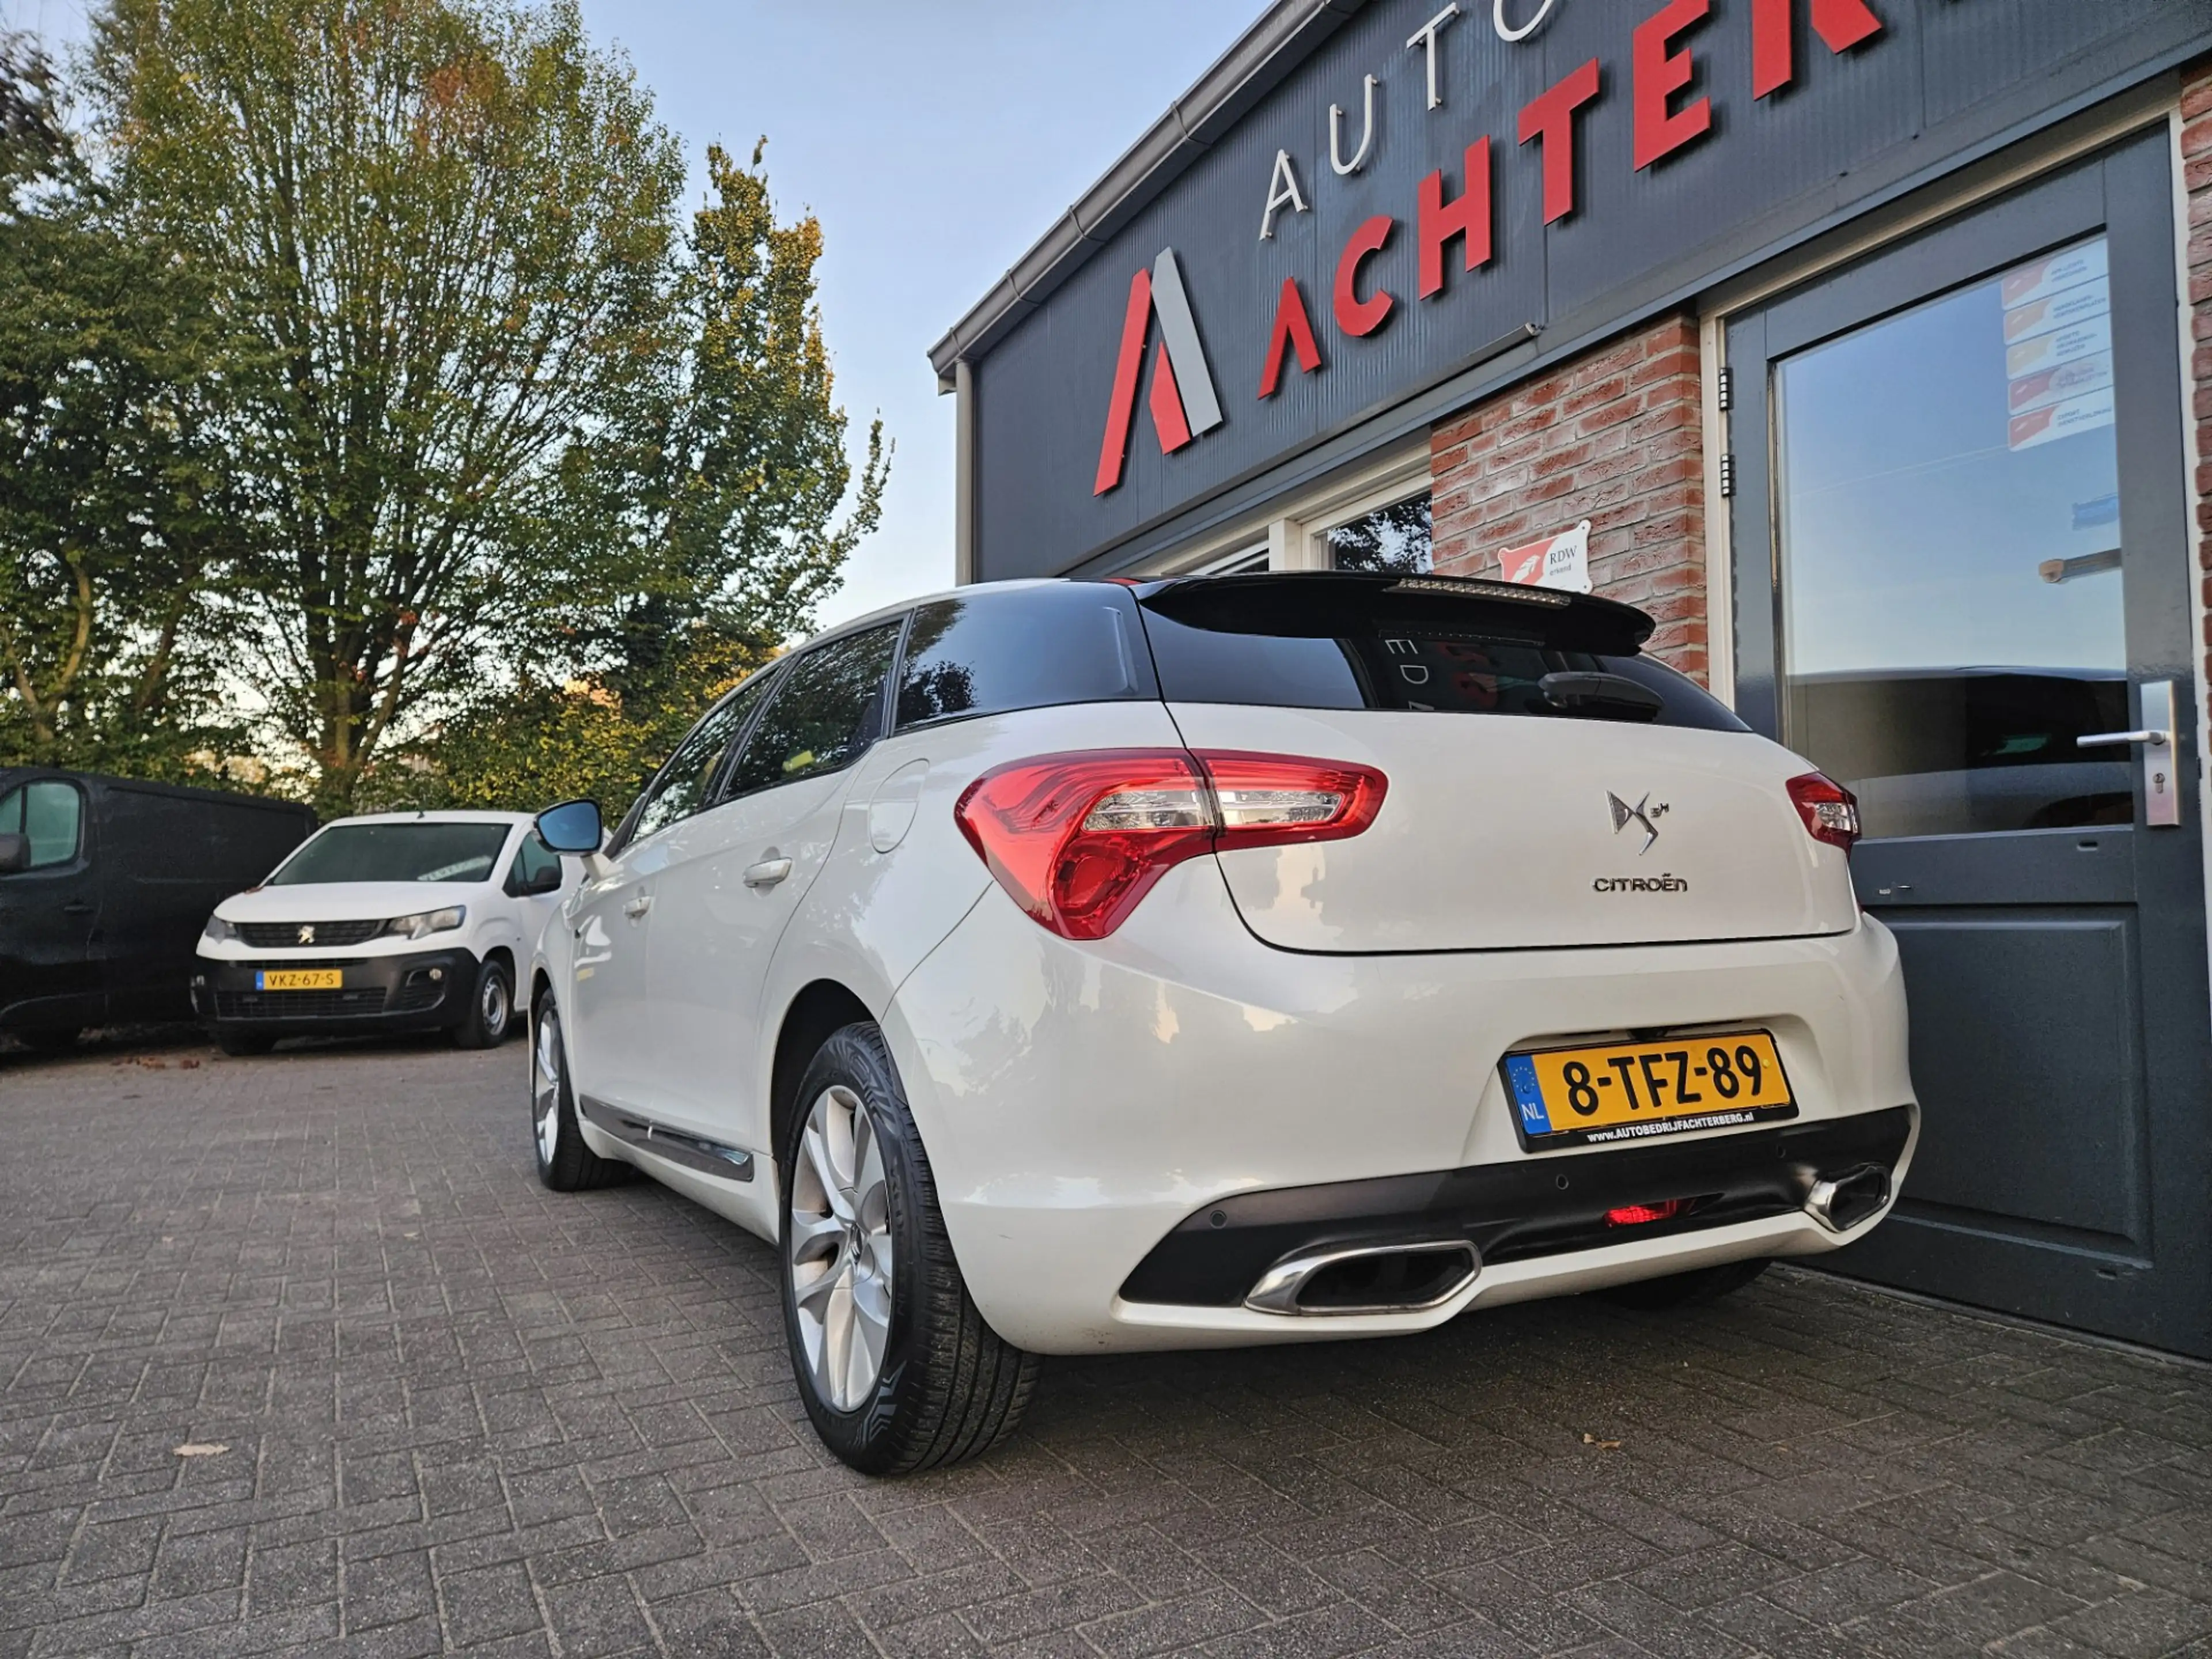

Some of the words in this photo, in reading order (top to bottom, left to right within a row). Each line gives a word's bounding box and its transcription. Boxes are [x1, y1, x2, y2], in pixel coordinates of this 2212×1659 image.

[1550, 545, 1577, 565] RDW
[1550, 564, 1571, 576] erkend
[269, 972, 335, 987] VKZ-67-S
[1563, 1046, 1763, 1116] 8-TFZ-89
[1522, 1103, 1545, 1121] NL
[1587, 1113, 1755, 1143] www.AUTOBEDRIJFACHTERBERG.nl
